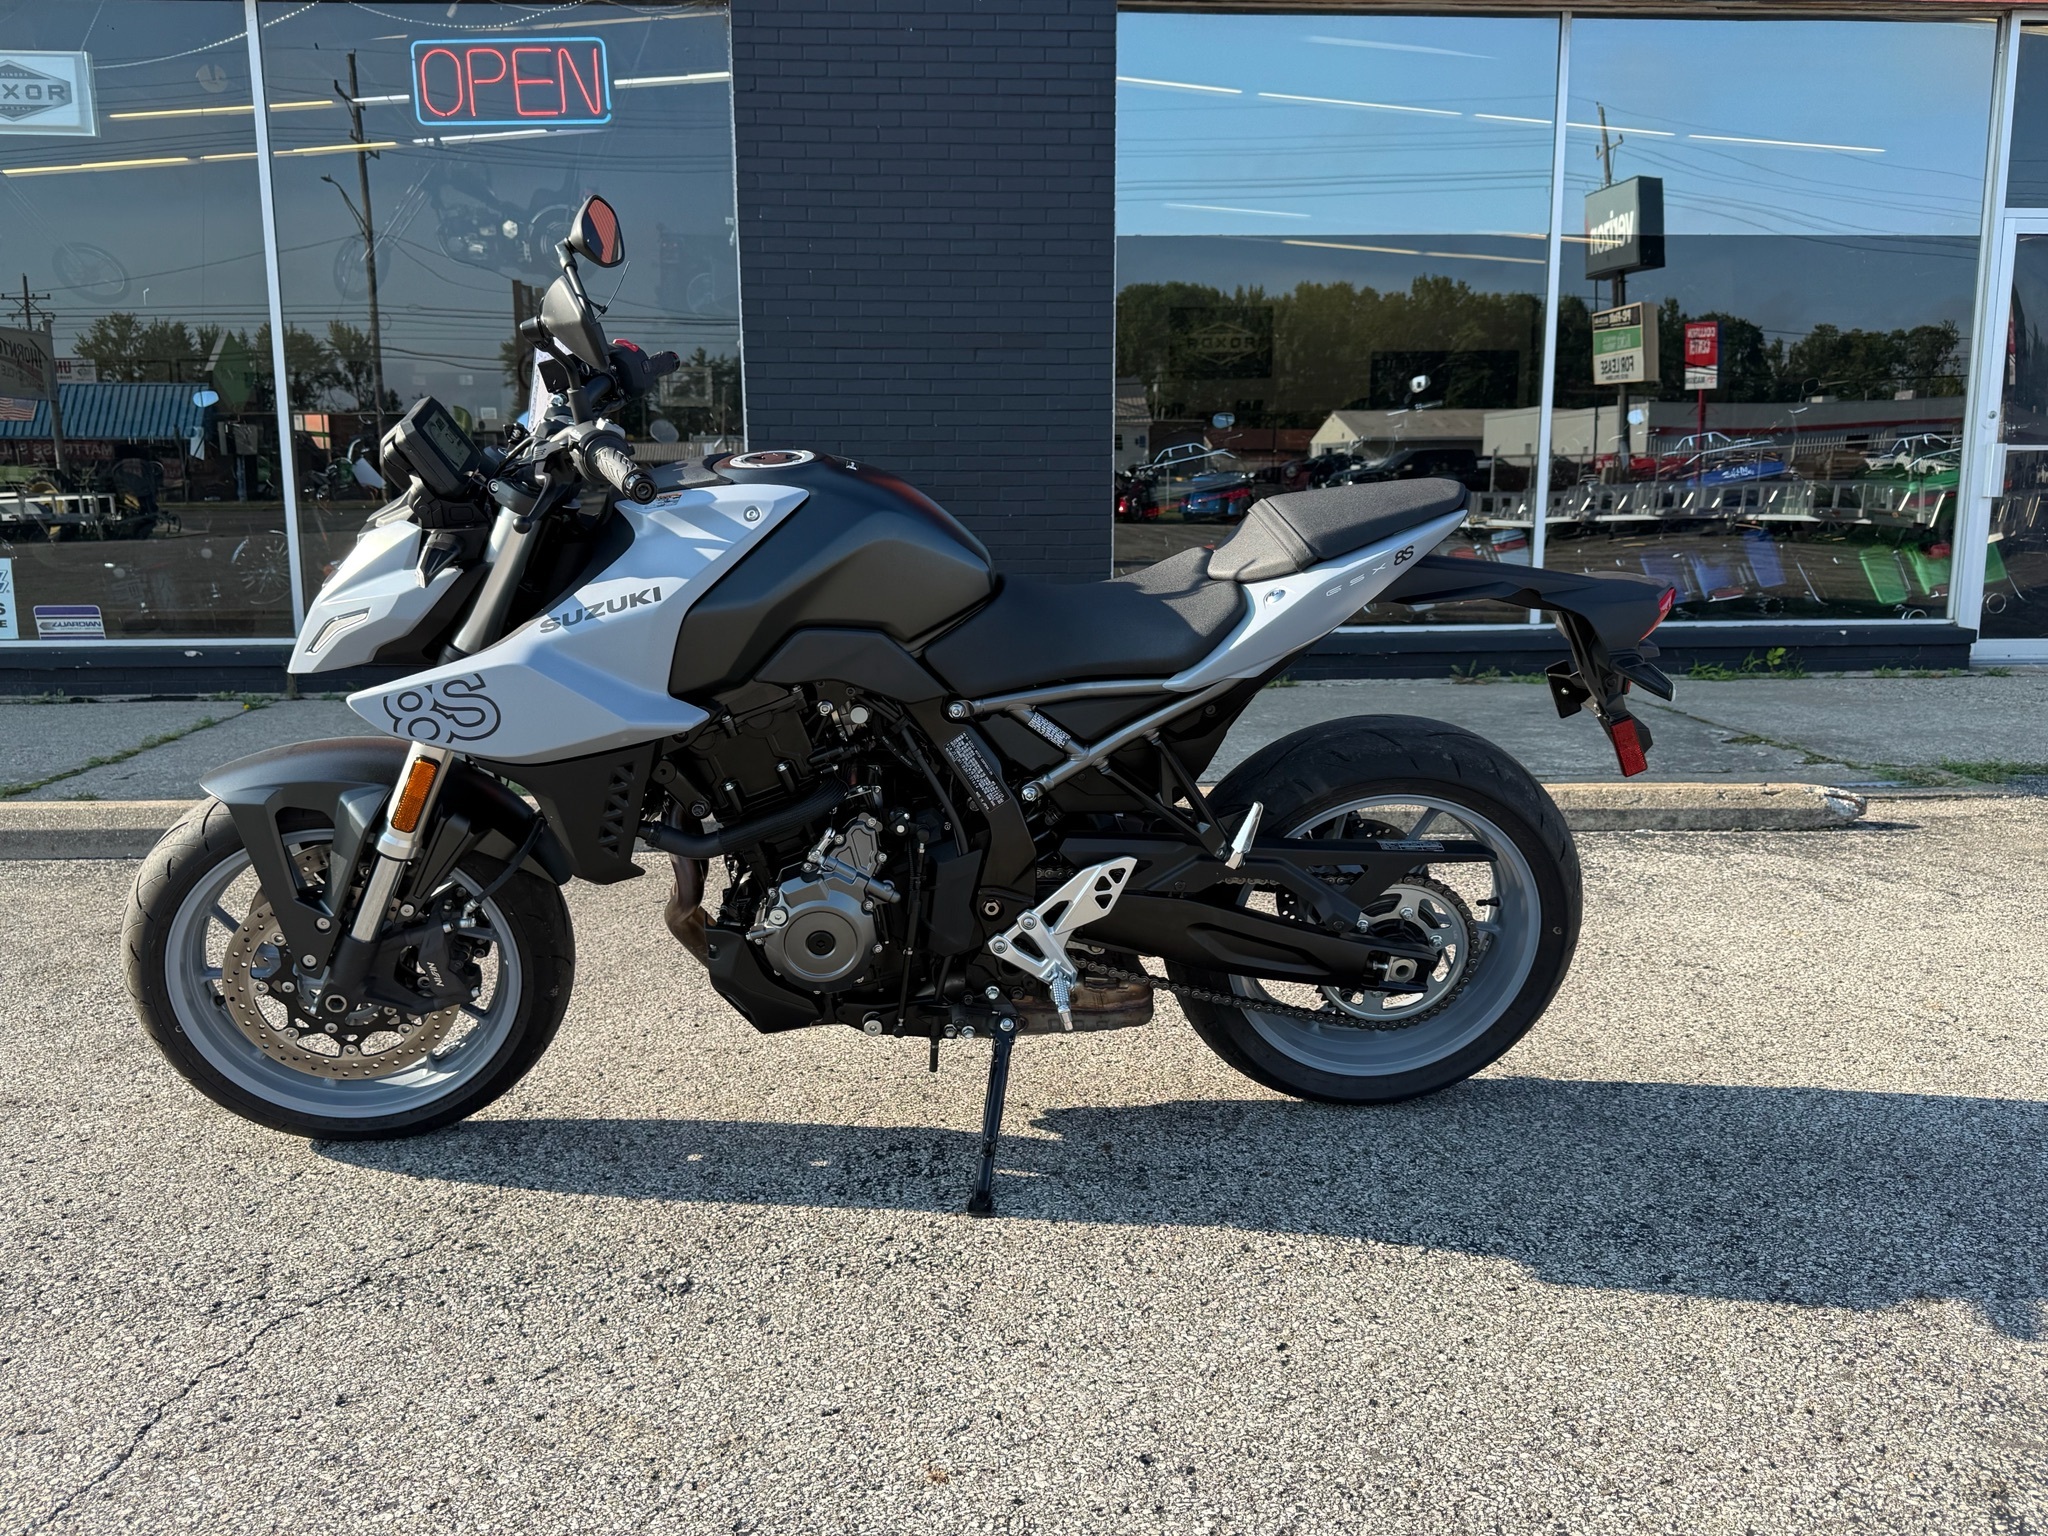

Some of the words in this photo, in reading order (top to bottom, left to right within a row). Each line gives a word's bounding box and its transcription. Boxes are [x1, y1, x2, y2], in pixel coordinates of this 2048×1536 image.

[420, 47, 602, 117] OPEN
[1393, 545, 1415, 566] 8S
[539, 586, 662, 634] SUZUKI
[382, 672, 502, 744] 8S
